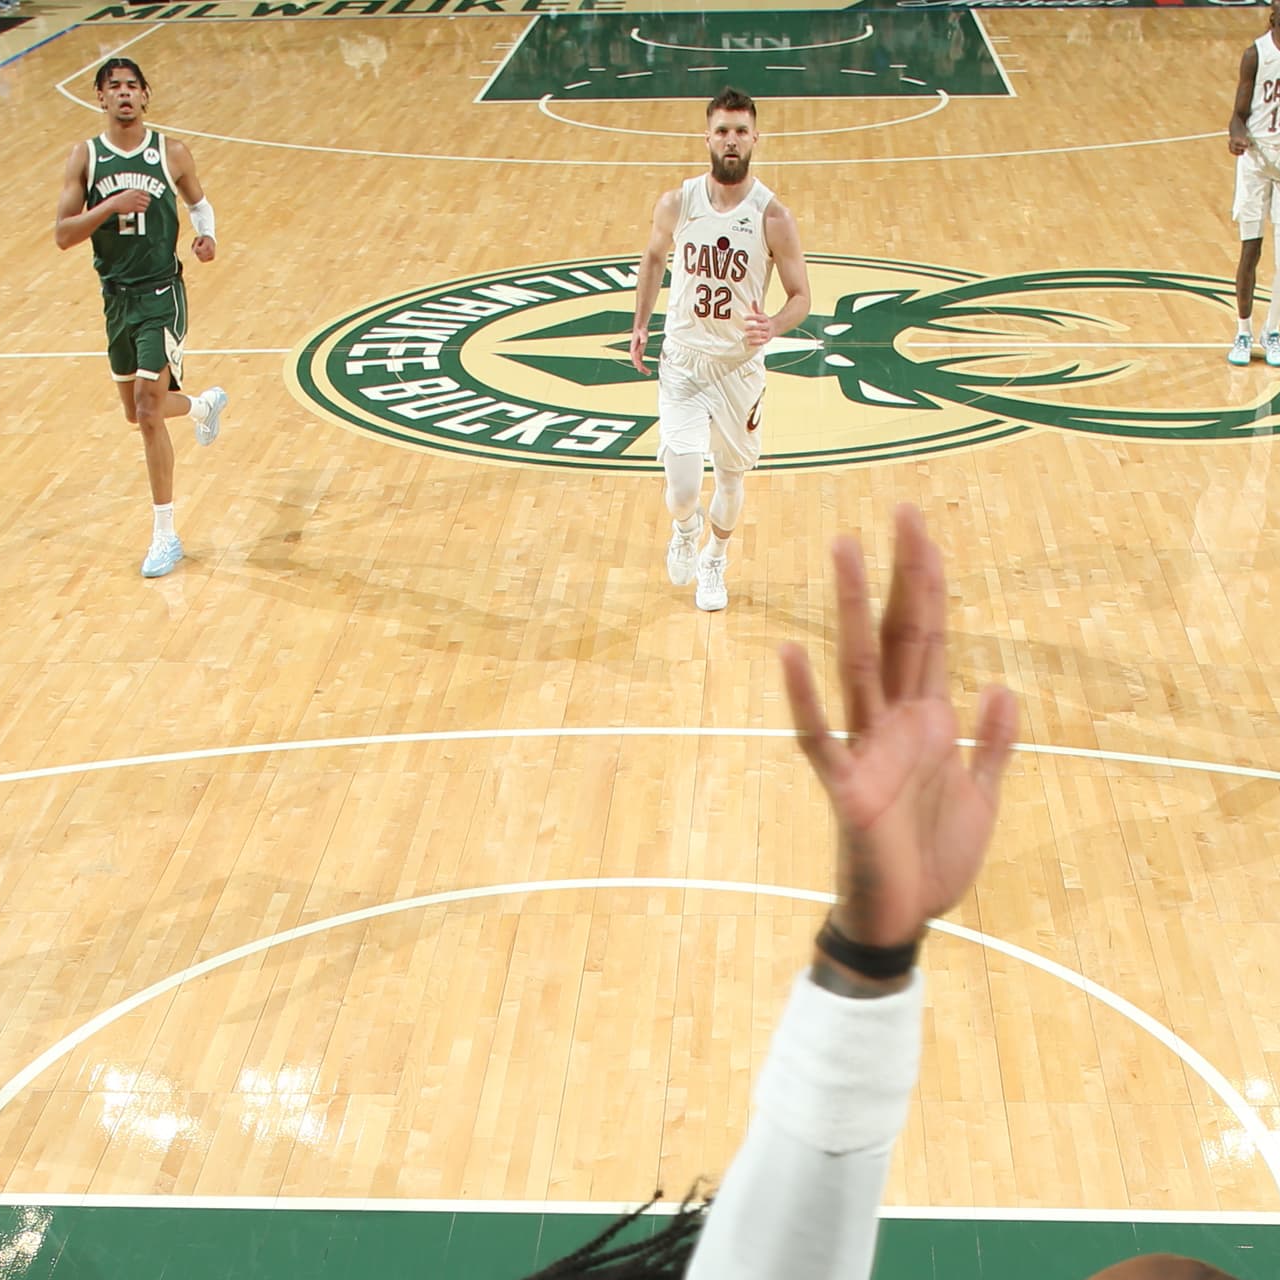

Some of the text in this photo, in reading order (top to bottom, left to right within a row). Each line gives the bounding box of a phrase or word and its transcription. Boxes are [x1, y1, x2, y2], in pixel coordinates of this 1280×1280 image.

[85, 0, 627, 21] MILWAUKEE
[96, 172, 166, 199] MILWAUKEE
[684, 242, 748, 282] CAVS
[694, 284, 732, 319] 32
[345, 264, 640, 452] MILWAUKEE BUCKS
